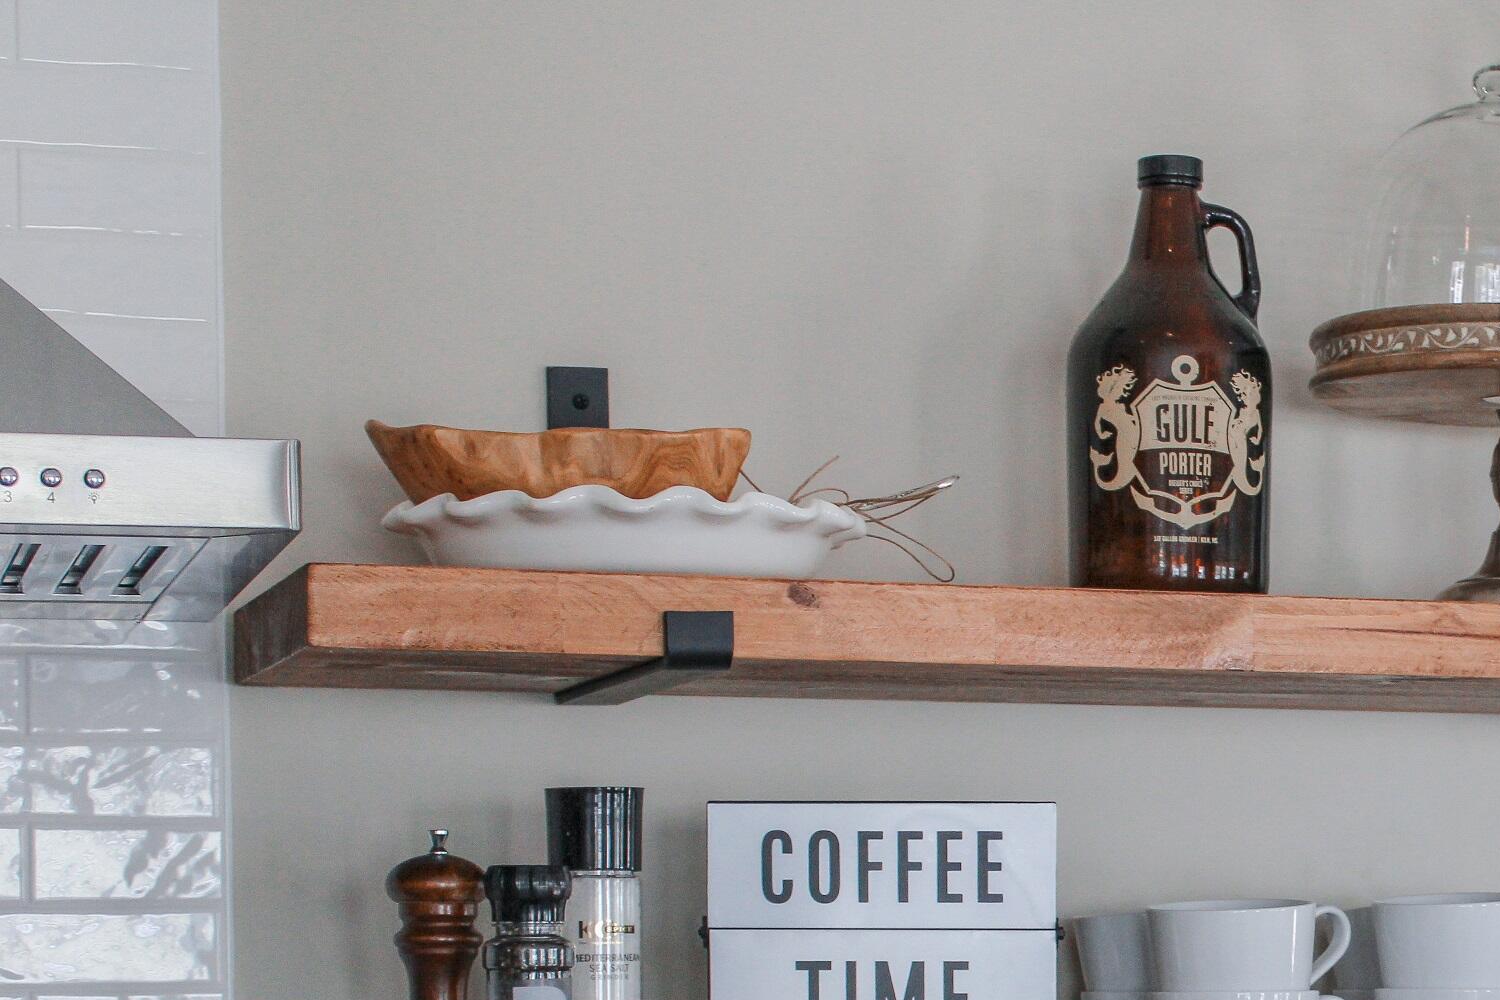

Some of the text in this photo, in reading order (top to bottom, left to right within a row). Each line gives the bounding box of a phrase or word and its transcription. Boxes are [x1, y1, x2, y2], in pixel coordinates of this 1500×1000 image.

[1159, 451, 1212, 477] PORTER
[3, 490, 56, 504] 3 4
[761, 829, 1004, 904] COFFEE
